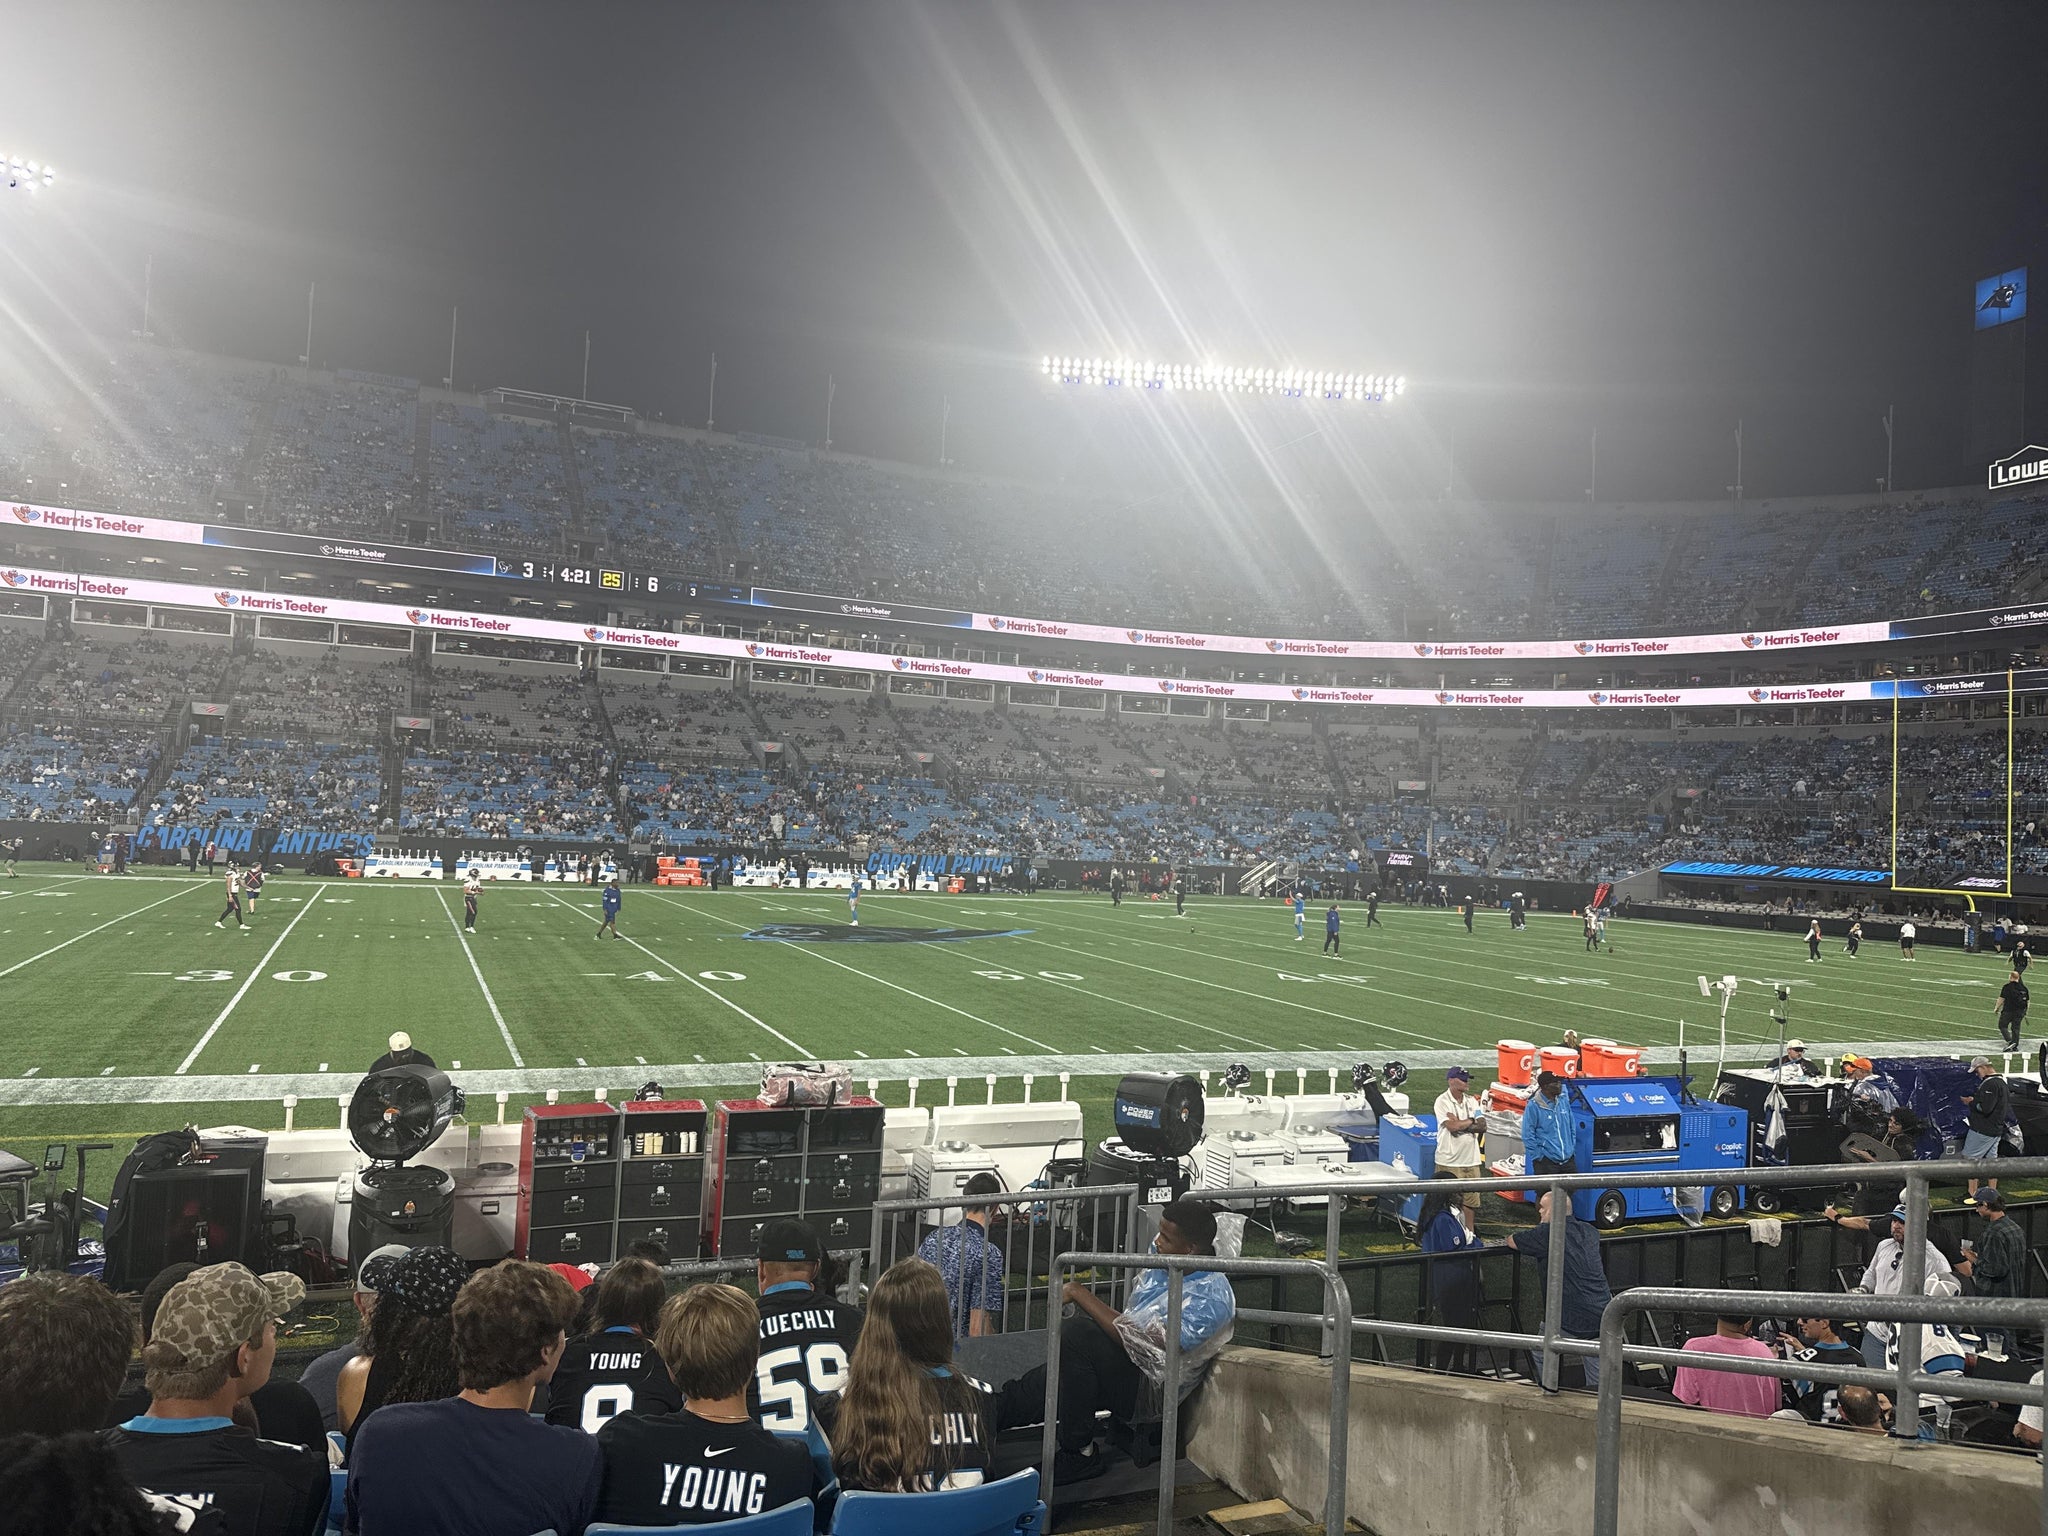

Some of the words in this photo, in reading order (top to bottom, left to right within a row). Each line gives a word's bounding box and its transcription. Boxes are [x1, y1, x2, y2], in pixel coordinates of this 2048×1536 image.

[43, 511, 94, 528] Harris
[95, 517, 145, 534] Teeter
[334, 546, 359, 557] Harris
[360, 548, 387, 559] Teeter
[522, 562, 534, 578] 3
[560, 567, 591, 585] 4:21
[30, 575, 77, 592] Harris
[80, 580, 129, 596] Teeter
[602, 573, 621, 588] 25
[648, 577, 659, 593] 6
[690, 587, 697, 597] 3
[240, 595, 283, 610] Harris
[284, 598, 328, 615] Teeter
[852, 605, 871, 615] Harris
[870, 606, 892, 617] Teeter
[430, 613, 470, 628] Harris
[470, 616, 511, 632] Teeter
[2003, 612, 2028, 623] Harris
[1007, 621, 1034, 634] Harris
[1035, 622, 1068, 637] Teeter
[606, 630, 641, 645] Harris
[642, 633, 680, 648] Teeter
[1144, 633, 1174, 646] Harris
[1174, 635, 1206, 648] Teeter
[1764, 633, 1799, 646] Harris
[1800, 630, 1841, 643] Teeter
[1284, 642, 1315, 654] Harris
[1315, 643, 1349, 655] Teeter
[1434, 644, 1467, 656] Harris
[1467, 644, 1505, 657] Teeter
[1595, 642, 1631, 654] Harris
[1631, 640, 1669, 653] Teeter
[765, 647, 798, 661] Harris
[798, 649, 832, 664] Teeter
[910, 660, 940, 673] Harris
[941, 662, 972, 676] Teeter
[1045, 673, 1074, 685] Harris
[1074, 675, 1104, 687] Teeter
[1936, 683, 1959, 692] Harris
[1959, 680, 1985, 690] Teeter
[1175, 682, 1204, 693] Harris
[1204, 684, 1235, 696] Teeter
[1310, 690, 1339, 702] Harris
[1339, 691, 1374, 702] Teeter
[1770, 689, 1806, 702] Harris
[1807, 686, 1845, 700] Teeter
[1455, 693, 1488, 704] Harris
[1489, 694, 1524, 705] Teeter
[1609, 693, 1643, 705] Harris
[1643, 692, 1681, 704] Teeter
[271, 832, 377, 857] ANTHERS
[342, 862, 350, 871] G
[377, 859, 403, 867] CAROLINA
[403, 860, 431, 868] PANTHERS
[493, 863, 519, 871] PANTHERS
[1681, 861, 1780, 876] CAROLINA
[1772, 866, 1893, 882] PANTHERS
[1520, 1054, 1532, 1071] G
[1564, 1059, 1576, 1076] G
[1625, 1058, 1636, 1073] G
[1127, 1106, 1154, 1117] POWER
[1721, 1142, 1742, 1151] Copilot
[589, 1352, 642, 1370] YOUNG
[756, 1341, 849, 1431] 59
[660, 1462, 768, 1514] YOUNG
